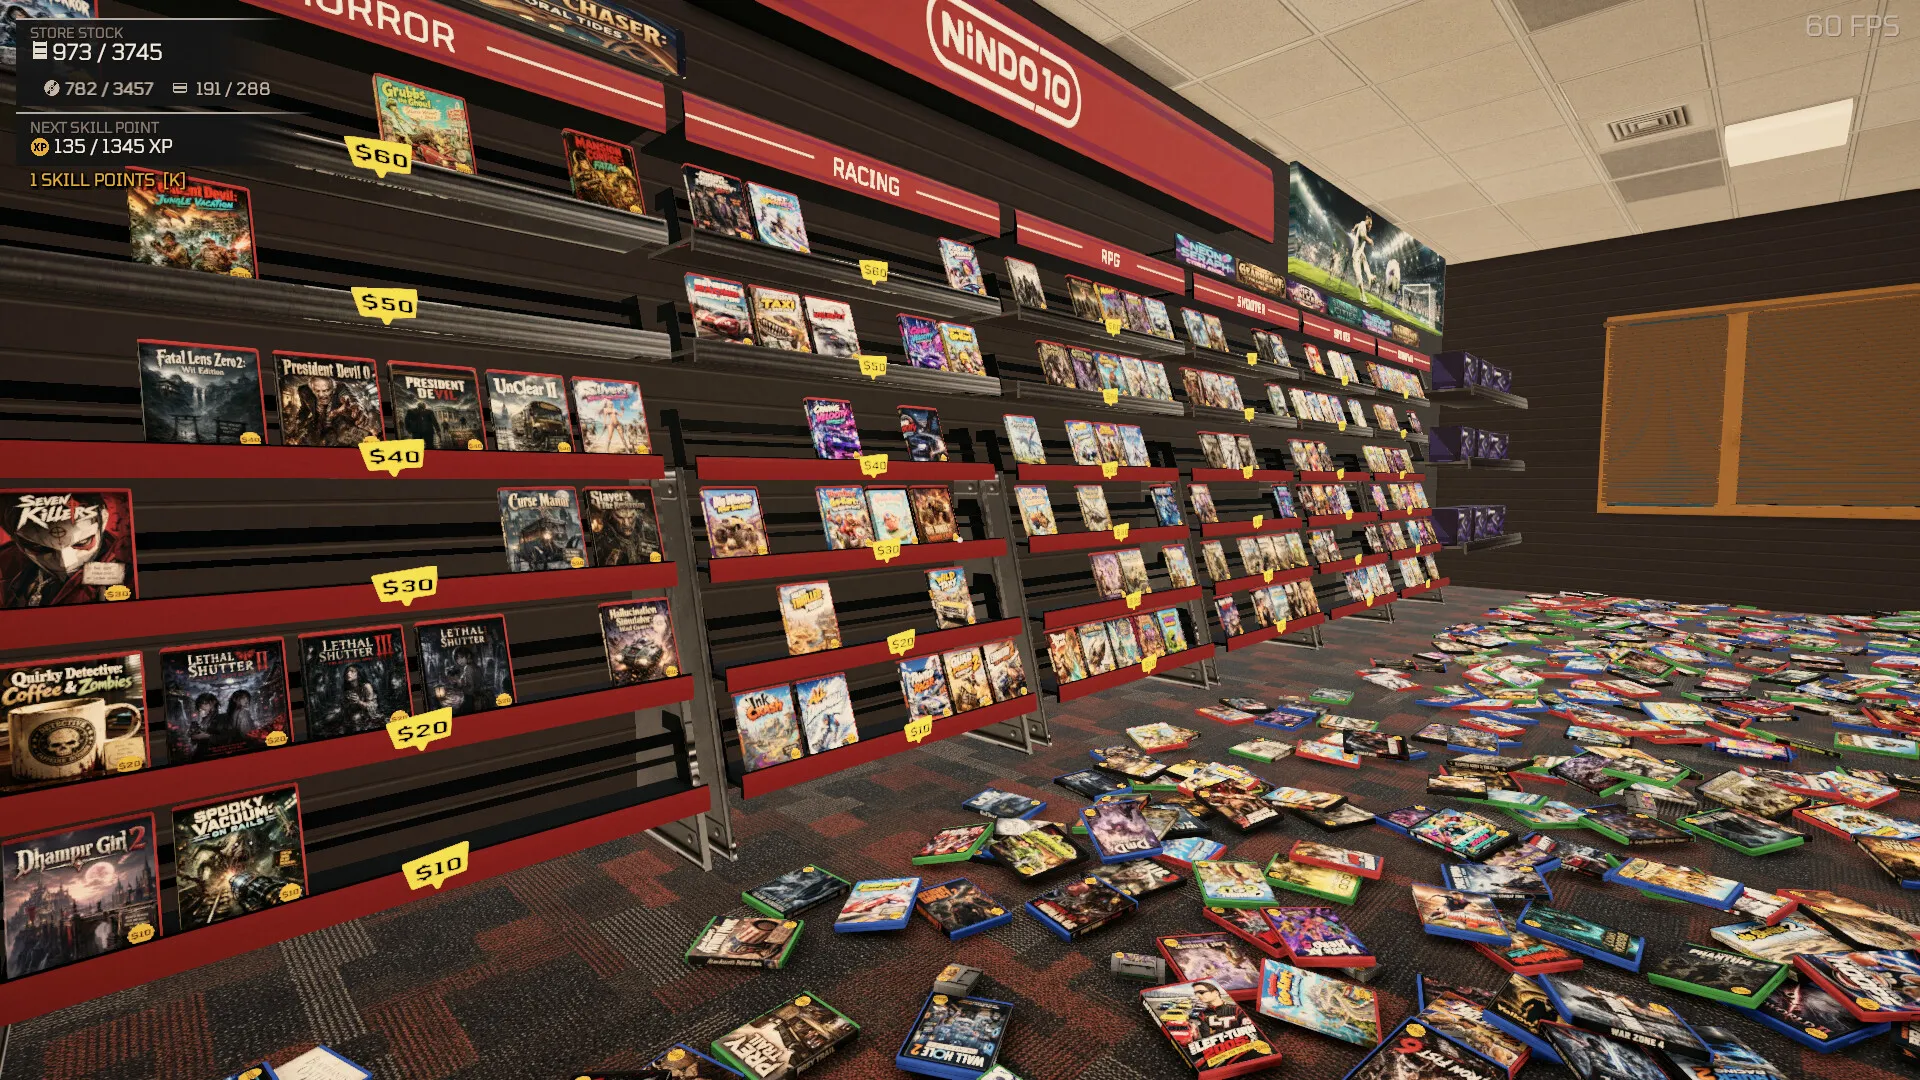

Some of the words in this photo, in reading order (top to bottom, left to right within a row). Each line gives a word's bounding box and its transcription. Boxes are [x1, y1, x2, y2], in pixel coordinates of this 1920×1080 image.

[303, 0, 456, 54] ORROR
[576, 16, 623, 39] TIDES
[381, 81, 426, 100] Grubbs
[1041, 67, 1071, 109] 10
[356, 143, 407, 168] $60
[575, 136, 622, 156] MANSION
[593, 160, 618, 173] FATAL
[833, 156, 900, 197] RACING
[155, 194, 192, 206] JUNGLE
[194, 197, 234, 209] VACATION
[1101, 248, 1121, 268] RPG
[1180, 248, 1231, 273] SERAPH
[1189, 241, 1223, 261] NEON
[863, 264, 887, 278] $60
[362, 294, 413, 313] $50
[761, 298, 796, 311] TAXI
[156, 349, 186, 368] Fatal
[187, 351, 213, 367] Lens
[863, 361, 886, 372] $50
[198, 367, 225, 377] Edition
[282, 358, 334, 377] President
[335, 362, 362, 379] Devil
[405, 376, 466, 393] PRESIDENT
[493, 377, 545, 397] UnClear
[546, 383, 558, 399] II
[417, 388, 458, 401] DEVIL
[370, 448, 420, 465] $40
[863, 460, 887, 471] $40
[13, 493, 73, 508] SEVEN
[508, 492, 538, 511] Curse
[538, 492, 571, 508] Manor
[876, 544, 900, 556] $30
[383, 578, 433, 596] $30
[440, 626, 485, 639] LETHAL
[440, 635, 486, 649] SHUTTER
[321, 637, 374, 653] LETHAL
[373, 634, 395, 658] III
[892, 636, 915, 650] $20
[187, 651, 236, 666] LETHAL
[255, 650, 269, 672] II
[318, 647, 374, 663] SHUTTER
[972, 654, 981, 673] 2
[11, 669, 64, 689] Quirky
[65, 663, 124, 680] Detective:
[187, 660, 255, 679] SHUTTER
[2, 683, 63, 706] Coffee
[64, 681, 77, 695] &
[77, 675, 133, 697] Zombies
[746, 699, 784, 721] CRASH
[398, 721, 448, 742] $20
[909, 723, 930, 737] $10
[118, 759, 142, 770] $20
[193, 795, 264, 824] SPOOKY
[191, 802, 275, 837] VACUUM:
[211, 829, 228, 839] ON
[230, 818, 265, 832] RAILS
[14, 842, 94, 880] Dhampir
[96, 830, 128, 856] Girl
[129, 825, 147, 851] 2
[416, 856, 461, 881] $10
[131, 928, 152, 940] $10
[1208, 1015, 1237, 1029] LT
[754, 1033, 785, 1063] TRAIL
[1393, 1036, 1423, 1055] 6
[1610, 1027, 1632, 1039] WAR
[1632, 1033, 1657, 1047] ZONE
[1656, 1040, 1665, 1050] 4
[723, 1035, 786, 1078] PREY
[909, 1043, 920, 1055] 2
[920, 1048, 956, 1064] HOLE
[1418, 1048, 1455, 1069] FIST
[958, 1052, 985, 1068] WALL
